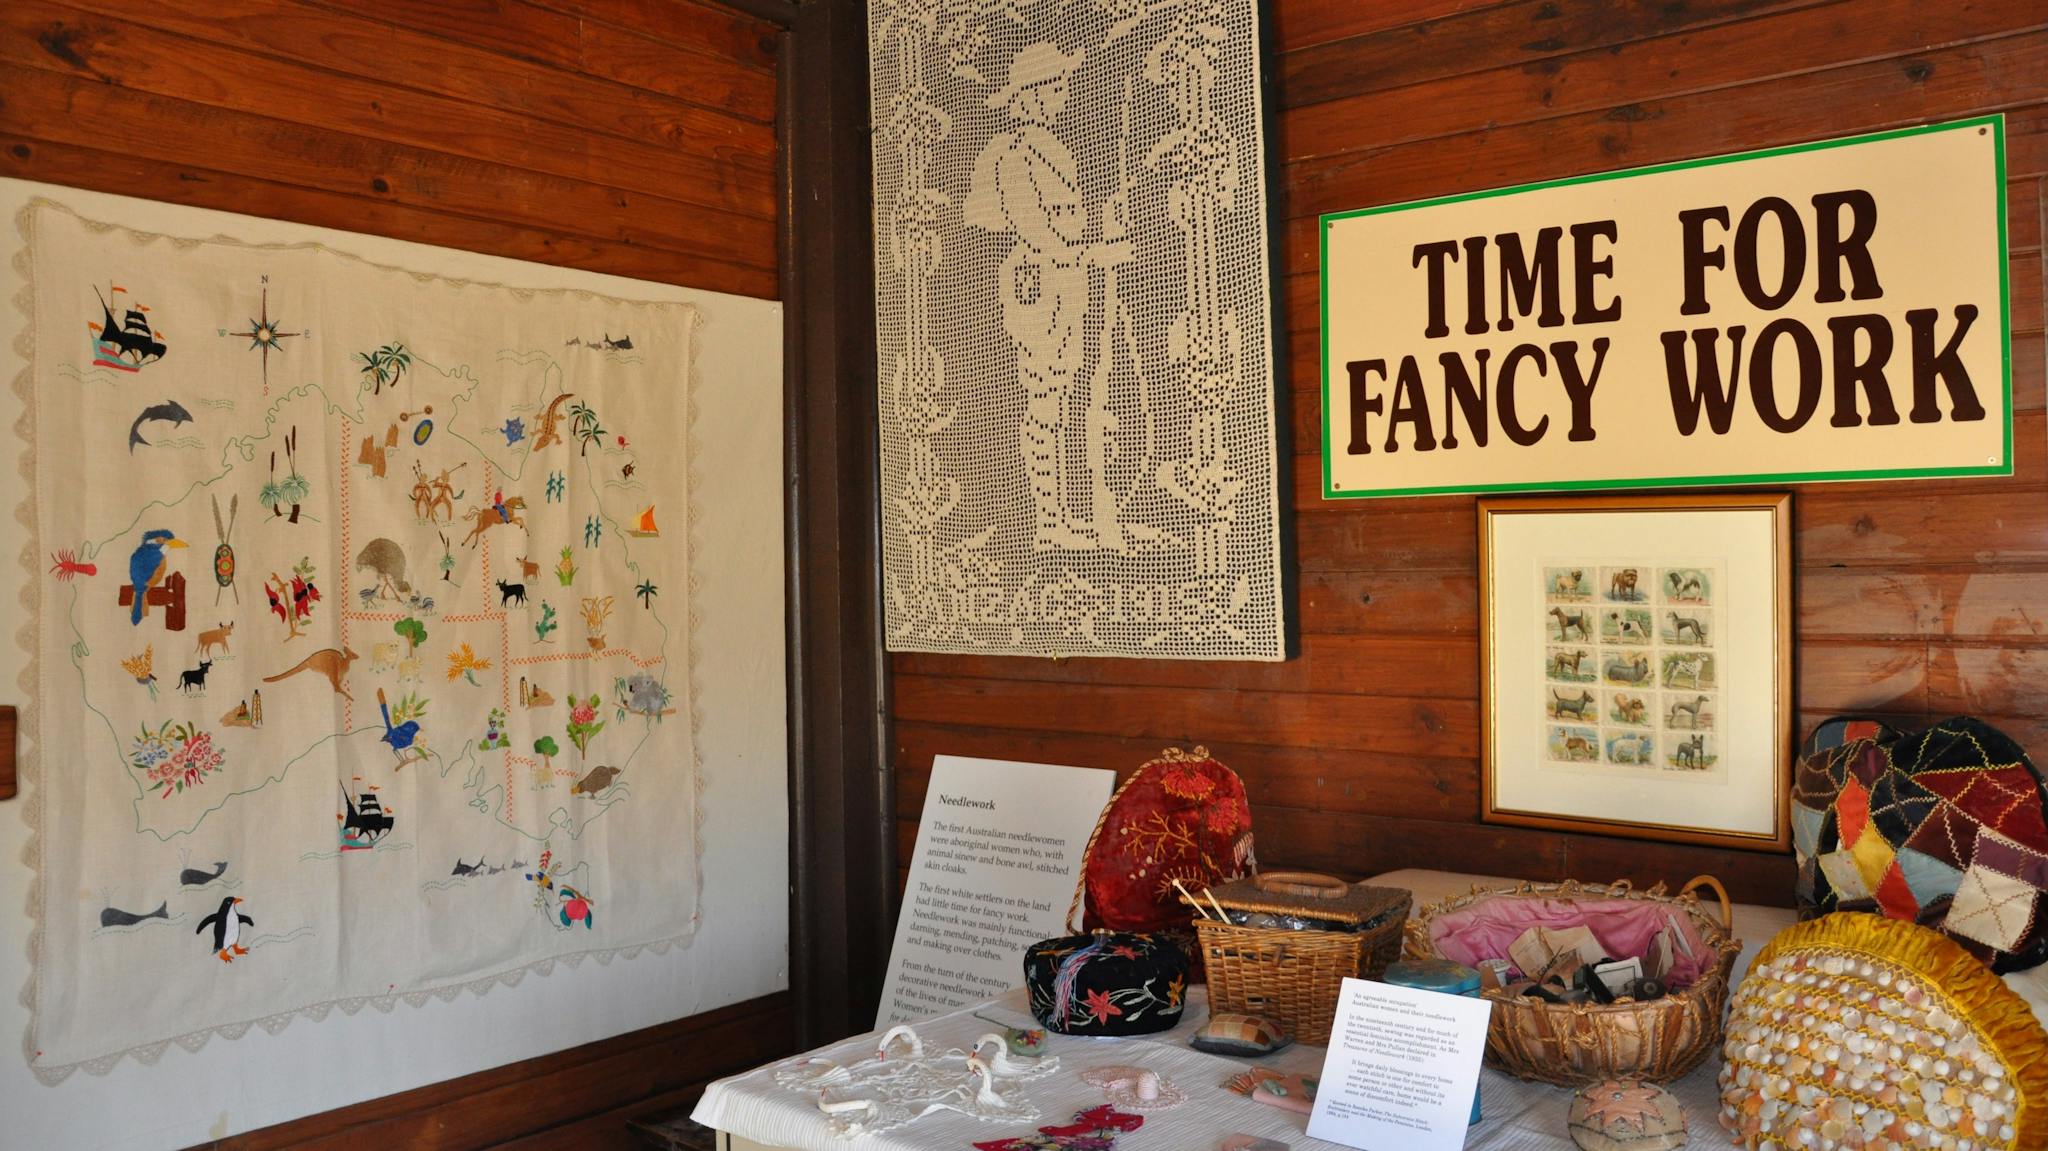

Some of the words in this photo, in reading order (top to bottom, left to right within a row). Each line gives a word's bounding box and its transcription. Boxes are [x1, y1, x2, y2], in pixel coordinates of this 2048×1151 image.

[1412, 219, 1622, 339] TIME
[1679, 188, 1884, 315] FOR
[261, 274, 269, 284] N
[1346, 337, 1611, 455] FANCY
[1660, 303, 1986, 437] WORK
[939, 793, 995, 810] Needlework
[933, 821, 947, 831] The
[948, 823, 964, 833] first
[966, 825, 1006, 838] Australian
[1008, 832, 1065, 845] needlewomen
[930, 837, 948, 845] were
[949, 837, 988, 850] aboriginal
[990, 845, 1020, 854] women
[1022, 847, 1042, 859] who,
[1045, 850, 1064, 860] with
[924, 860, 940, 870] skin
[941, 863, 967, 874] cloaks.
[927, 848, 953, 858] animal
[954, 851, 976, 862] sinew
[978, 855, 993, 864] and
[995, 856, 1015, 867] bone
[1016, 861, 1033, 872] awl,
[1035, 863, 1069, 875] stitched
[915, 895, 930, 906] had
[931, 898, 949, 909] little
[950, 901, 968, 912] time
[969, 904, 981, 914] for
[982, 906, 1004, 921] fancy
[1006, 913, 1029, 922] work.
[919, 883, 933, 892] The
[934, 885, 950, 895] first
[951, 888, 973, 899] white
[974, 892, 1002, 904] settlers
[1017, 898, 1030, 908] the
[1032, 900, 1051, 911] land
[912, 909, 959, 924] Needlework
[961, 919, 976, 927] was
[978, 921, 1006, 934] mainly
[906, 937, 922, 945] and
[923, 940, 951, 953] making
[953, 946, 972, 955] over
[972, 948, 1002, 960] clothes.
[909, 922, 941, 938] darning,
[943, 930, 979, 944] mending,
[981, 936, 1018, 951] patching,
[898, 972, 938, 988] decorative
[939, 982, 985, 996] needlework
[901, 959, 922, 970] From
[923, 963, 936, 973] the
[937, 965, 954, 976] turn
[955, 970, 965, 978] of
[965, 971, 978, 981] the
[979, 975, 1011, 989] century
[895, 986, 905, 995] of
[905, 987, 918, 997] the
[918, 990, 936, 1001] lives
[937, 994, 947, 1003] of
[894, 1000, 929, 1014] Women's
